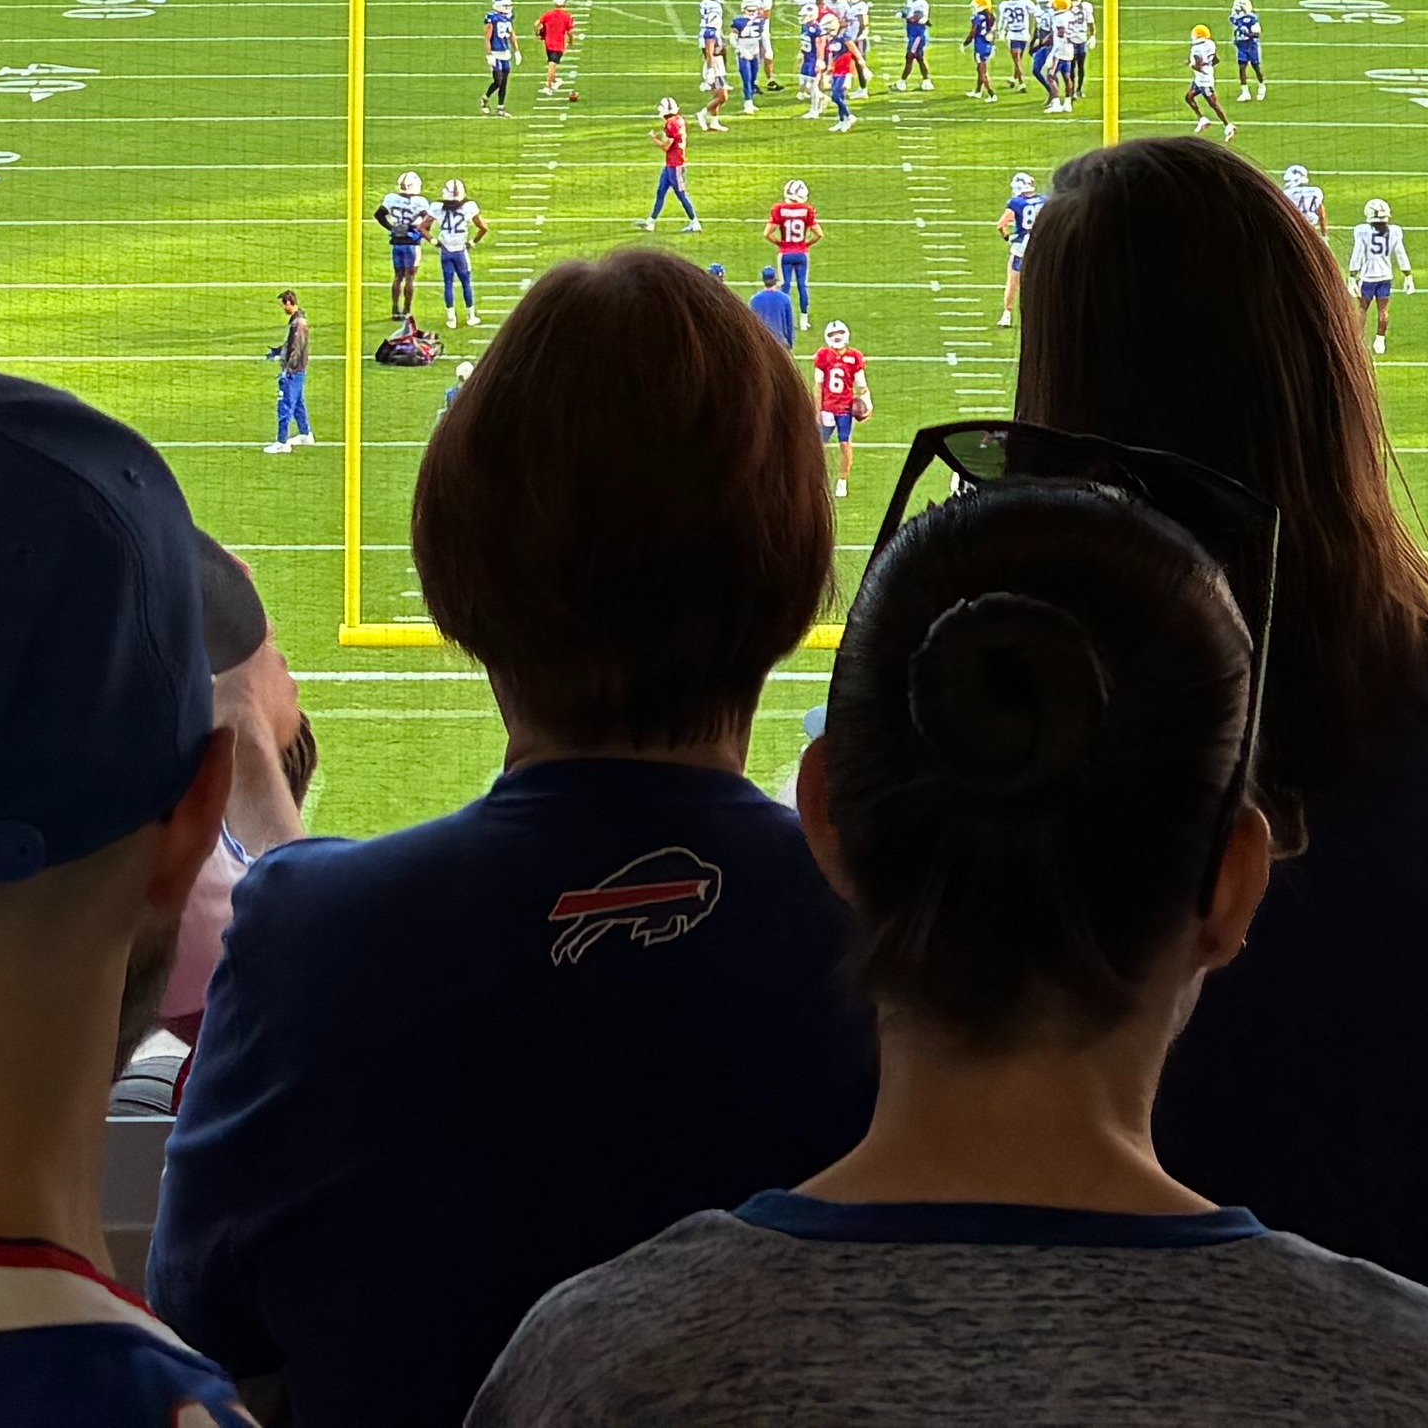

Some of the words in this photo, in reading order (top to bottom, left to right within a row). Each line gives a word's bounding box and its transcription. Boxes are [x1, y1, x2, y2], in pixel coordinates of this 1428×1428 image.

[441, 210, 466, 234] 42
[783, 219, 806, 243] 19
[1371, 233, 1390, 256] 51
[828, 367, 845, 394] 6
